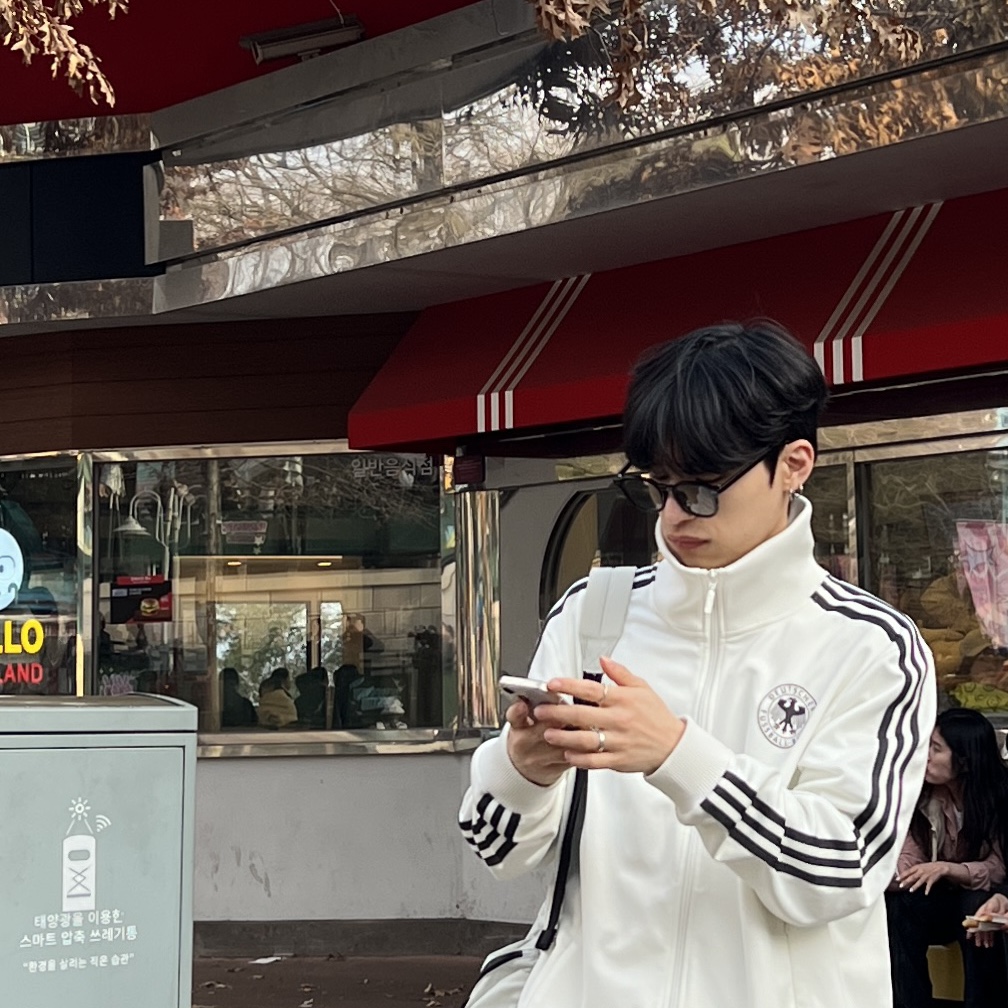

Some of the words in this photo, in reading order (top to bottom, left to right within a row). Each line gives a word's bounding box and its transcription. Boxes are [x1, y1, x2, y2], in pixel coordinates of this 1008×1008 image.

[351, 456, 433, 478] 일반음식점
[0, 618, 45, 654] LO
[0, 662, 44, 685] AND
[34, 911, 83, 929] 태양광을
[88, 908, 125, 925] 이용한
[19, 932, 57, 948] 스마트
[61, 930, 86, 946] 압축
[89, 925, 137, 942] 쓰레기통
